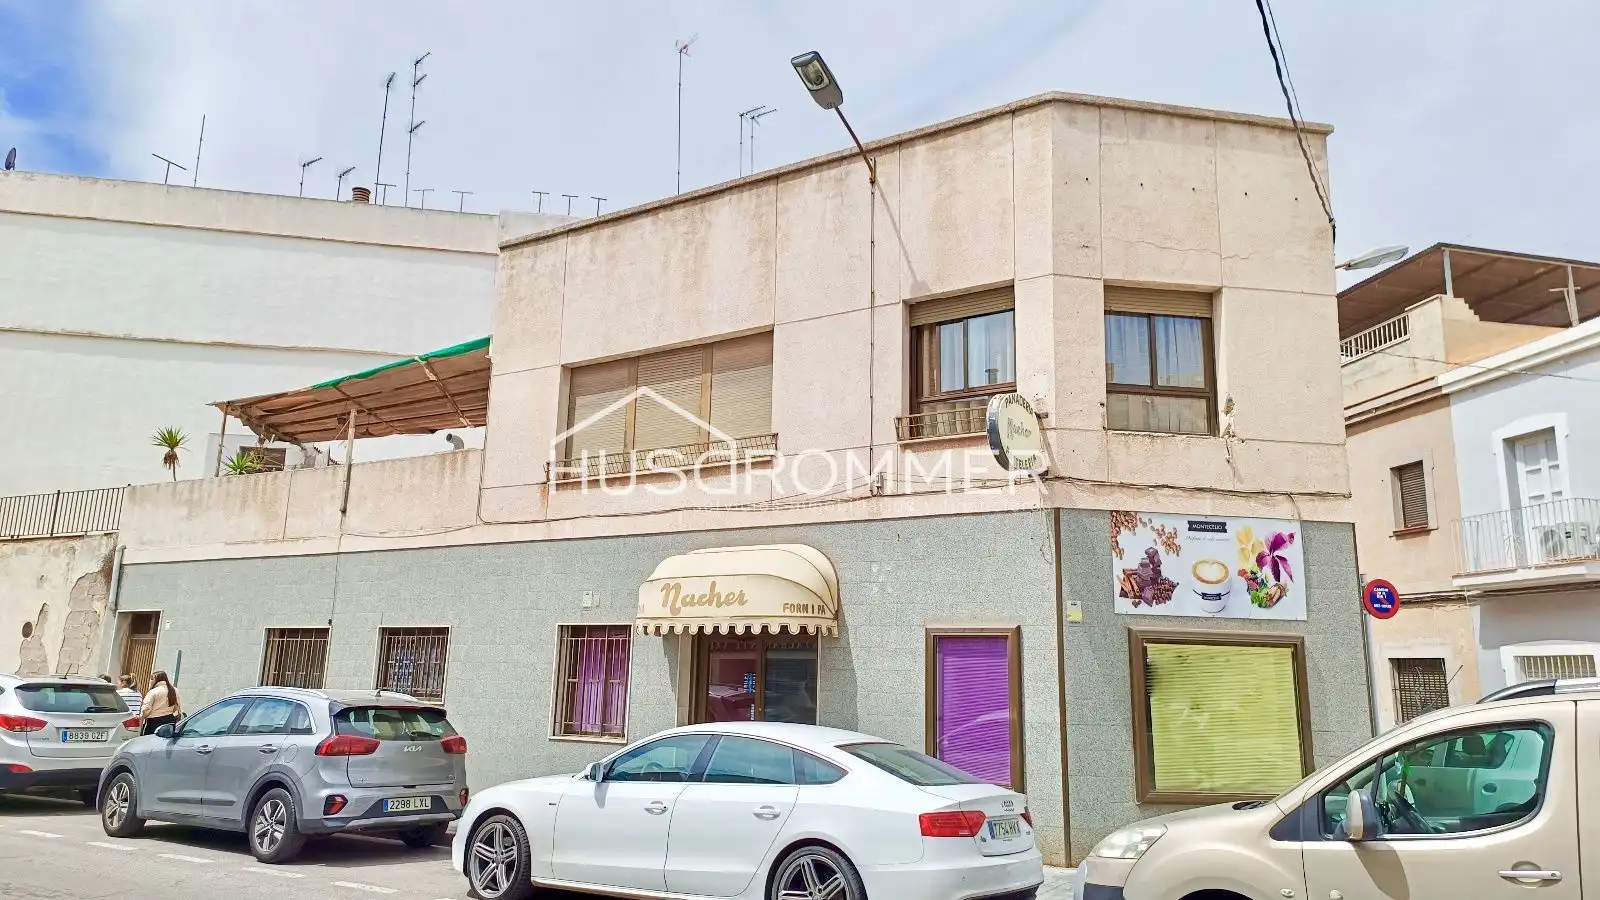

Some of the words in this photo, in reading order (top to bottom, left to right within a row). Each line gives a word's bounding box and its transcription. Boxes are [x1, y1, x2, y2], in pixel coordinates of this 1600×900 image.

[69, 731, 89, 740] 8839
[389, 799, 411, 810] 2298
[413, 798, 430, 809] LXL
